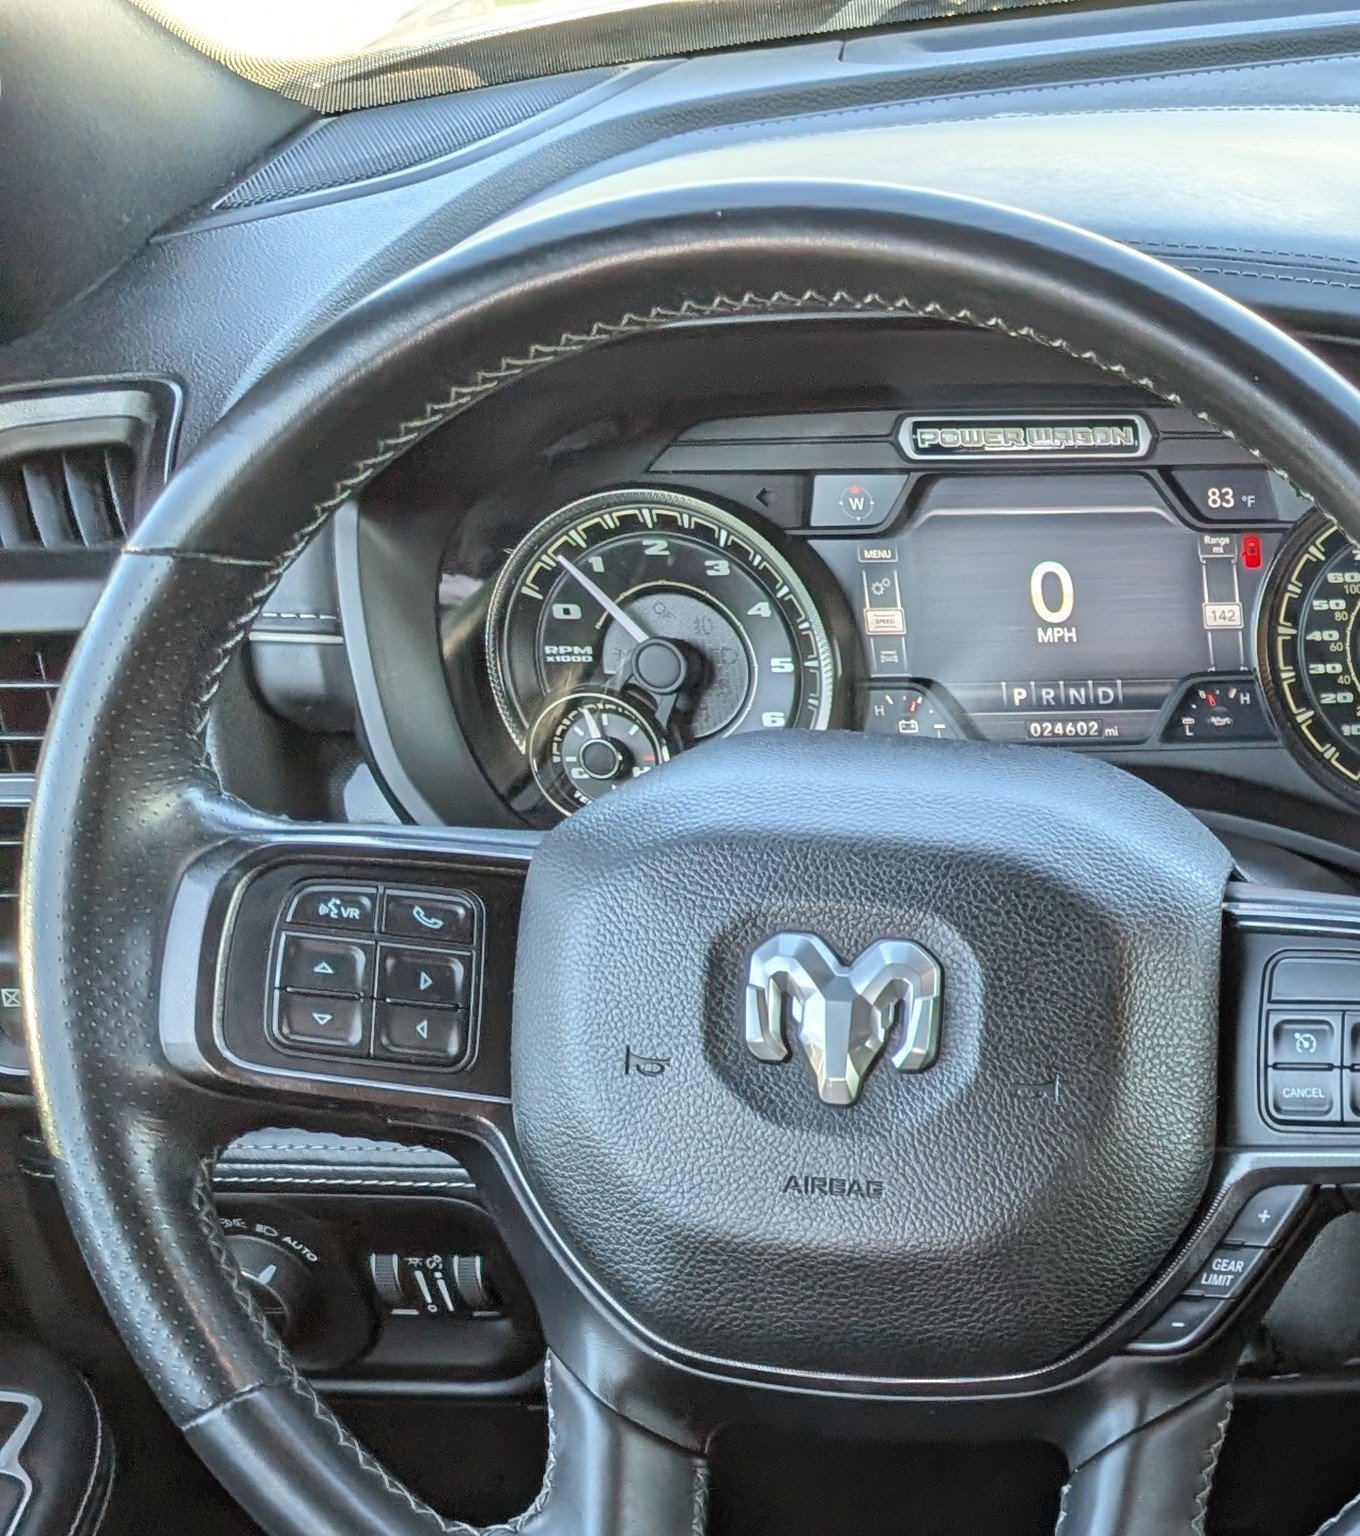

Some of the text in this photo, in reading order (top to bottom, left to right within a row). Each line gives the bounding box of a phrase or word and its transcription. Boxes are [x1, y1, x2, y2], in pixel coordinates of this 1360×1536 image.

[917, 426, 1136, 449] POWER WAGON
[849, 497, 864, 510] W
[1207, 487, 1255, 509] 83 °F
[641, 540, 670, 555] 2
[863, 549, 891, 559] MENU
[588, 556, 604, 572] 1
[704, 560, 730, 576] 3
[1327, 572, 1360, 584] 60
[1029, 560, 1074, 624] 0
[552, 603, 581, 619] 0
[747, 602, 771, 617] 4
[1312, 600, 1346, 610] 50
[1211, 609, 1236, 621] 142
[1334, 611, 1348, 622] 80
[1037, 627, 1076, 642] MPH
[1305, 630, 1339, 641] 40
[544, 645, 592, 655] RPM
[1329, 641, 1343, 652] 60
[770, 657, 793, 673] 5
[1309, 663, 1342, 675] 30
[1337, 675, 1350, 685] 40
[1013, 688, 1114, 706] P R N D
[1320, 692, 1353, 704] 20
[761, 712, 785, 727] 6
[1030, 721, 1118, 737] 024602 mi
[341, 906, 360, 919] VR
[1282, 1087, 1325, 1099] CANCEL
[783, 1175, 884, 1199] AIRBAG
[282, 1236, 318, 1263] AUTO
[1212, 1258, 1244, 1272] GEAR
[1201, 1272, 1234, 1286] LIMIT
